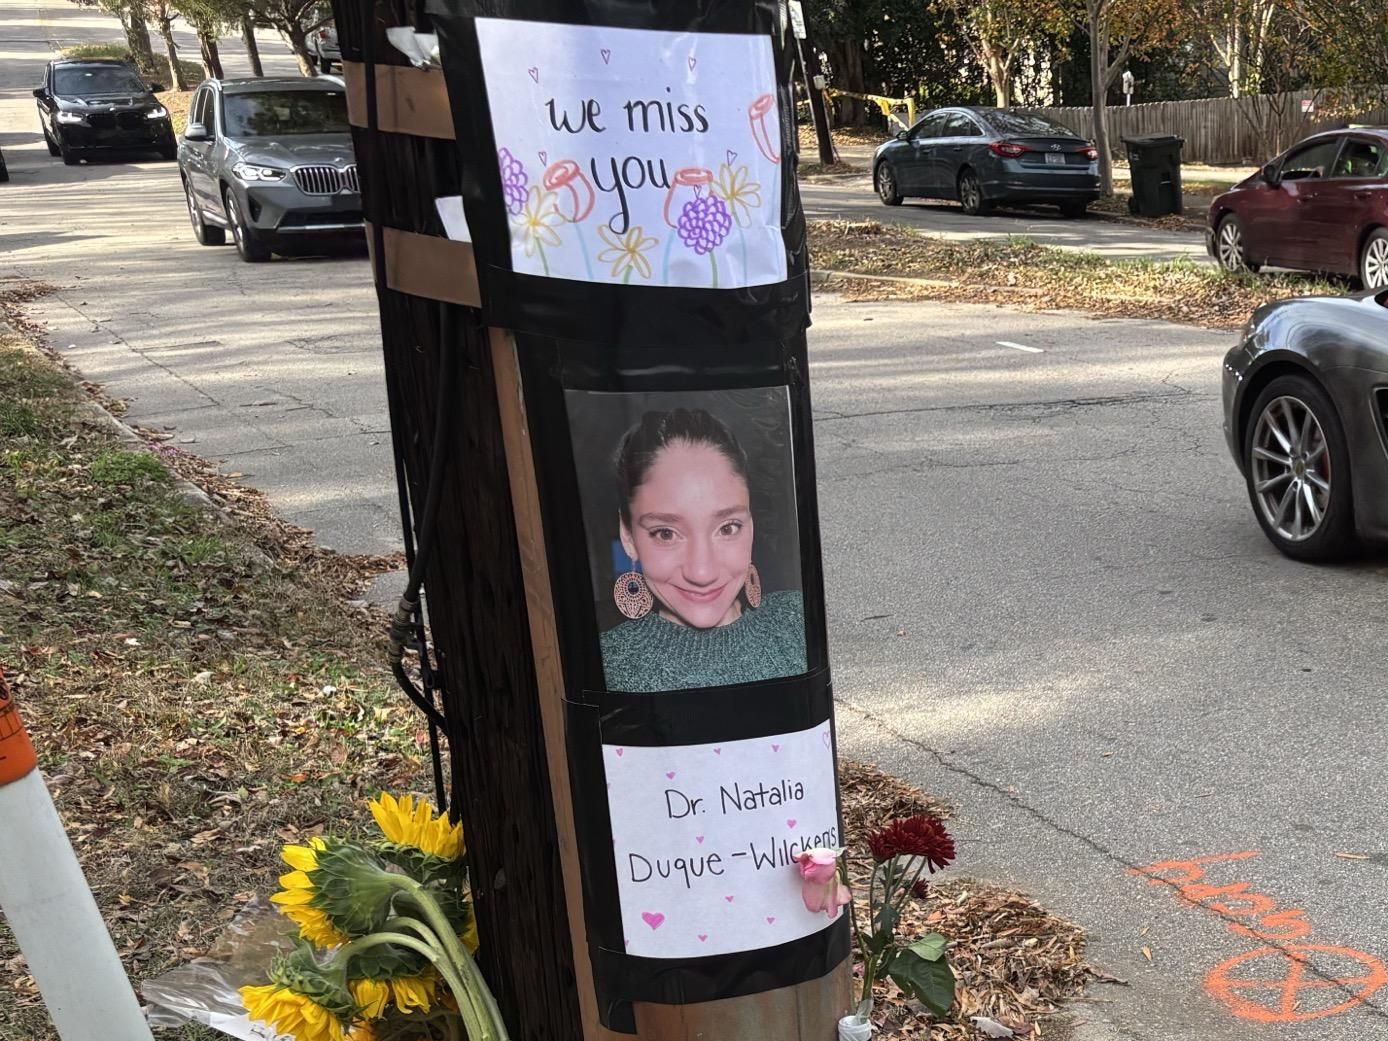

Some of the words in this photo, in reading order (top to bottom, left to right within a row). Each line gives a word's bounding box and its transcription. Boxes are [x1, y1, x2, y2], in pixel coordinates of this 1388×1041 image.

[545, 97, 607, 134] we
[623, 87, 710, 134] miss
[590, 155, 673, 235] you
[664, 788, 706, 819] Dr.
[719, 779, 805, 815] Natalia
